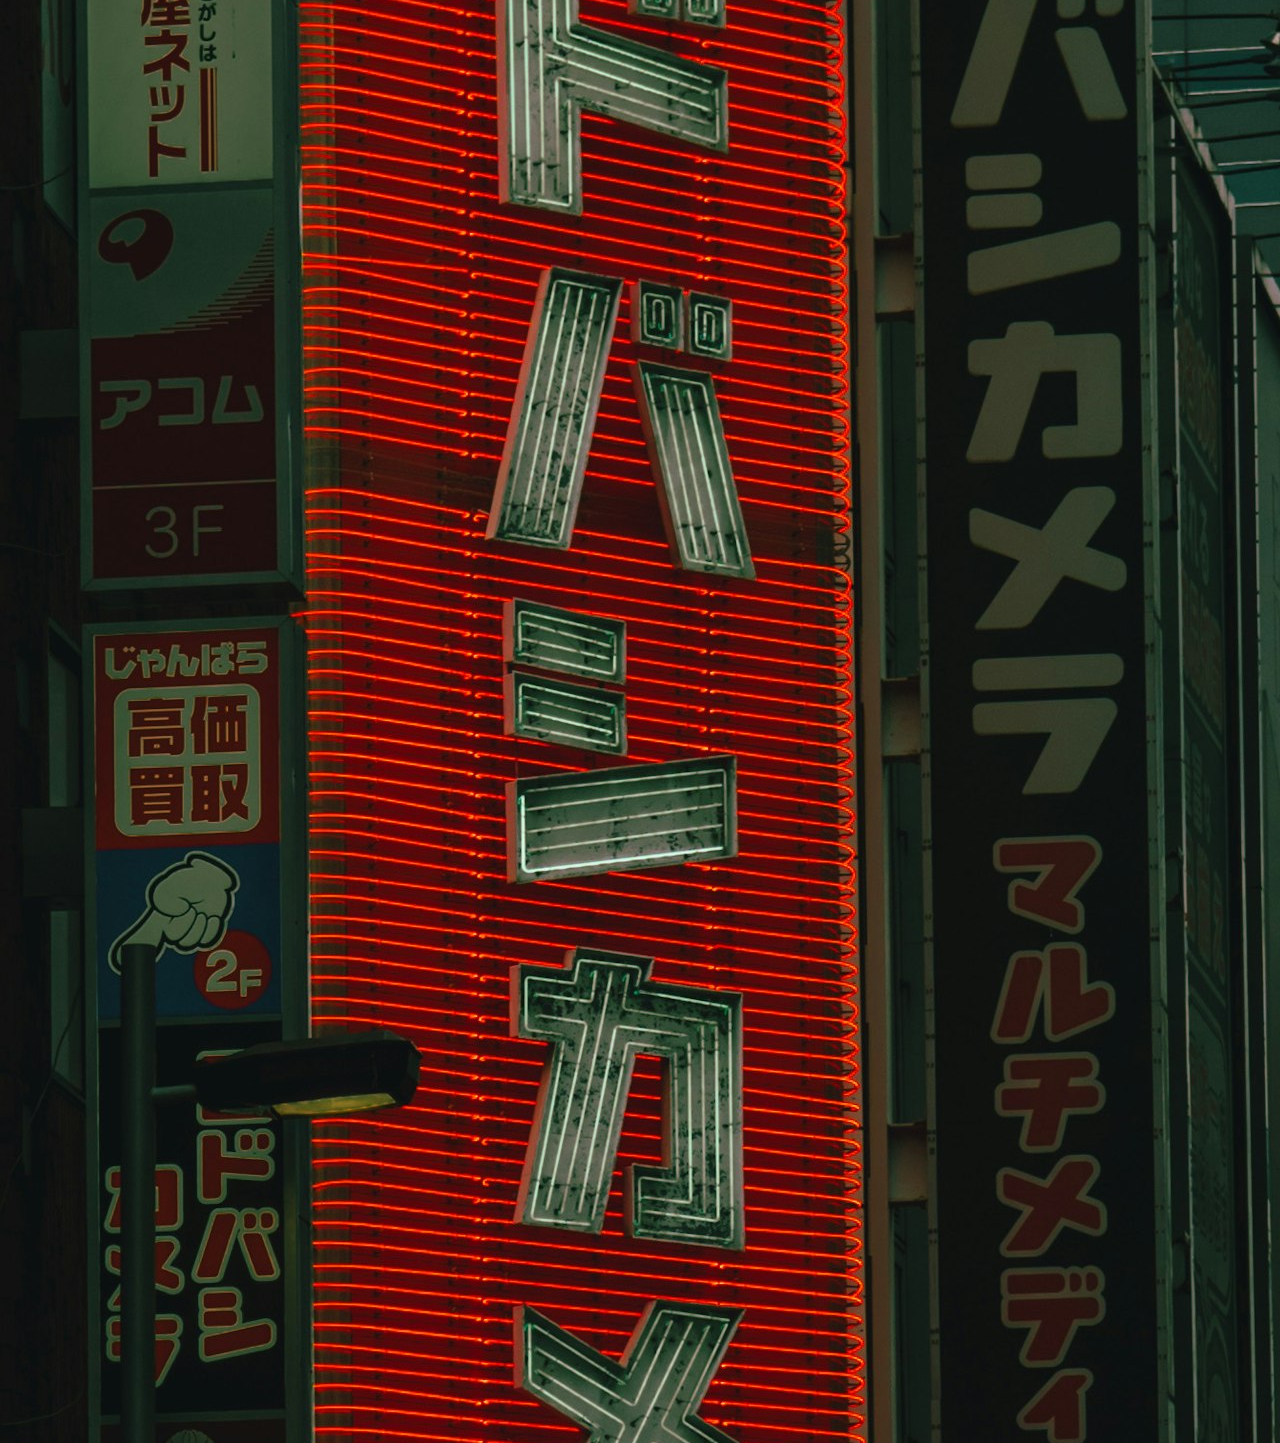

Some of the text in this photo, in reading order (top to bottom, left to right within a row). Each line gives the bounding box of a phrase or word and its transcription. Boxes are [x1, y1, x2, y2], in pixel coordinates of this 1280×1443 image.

[99, 374, 265, 431] アコム
[144, 504, 224, 559] 3F
[104, 641, 270, 681] じゃんぱら
[128, 695, 250, 758] 高価
[130, 763, 250, 825] 買取
[205, 949, 263, 998] 2F
